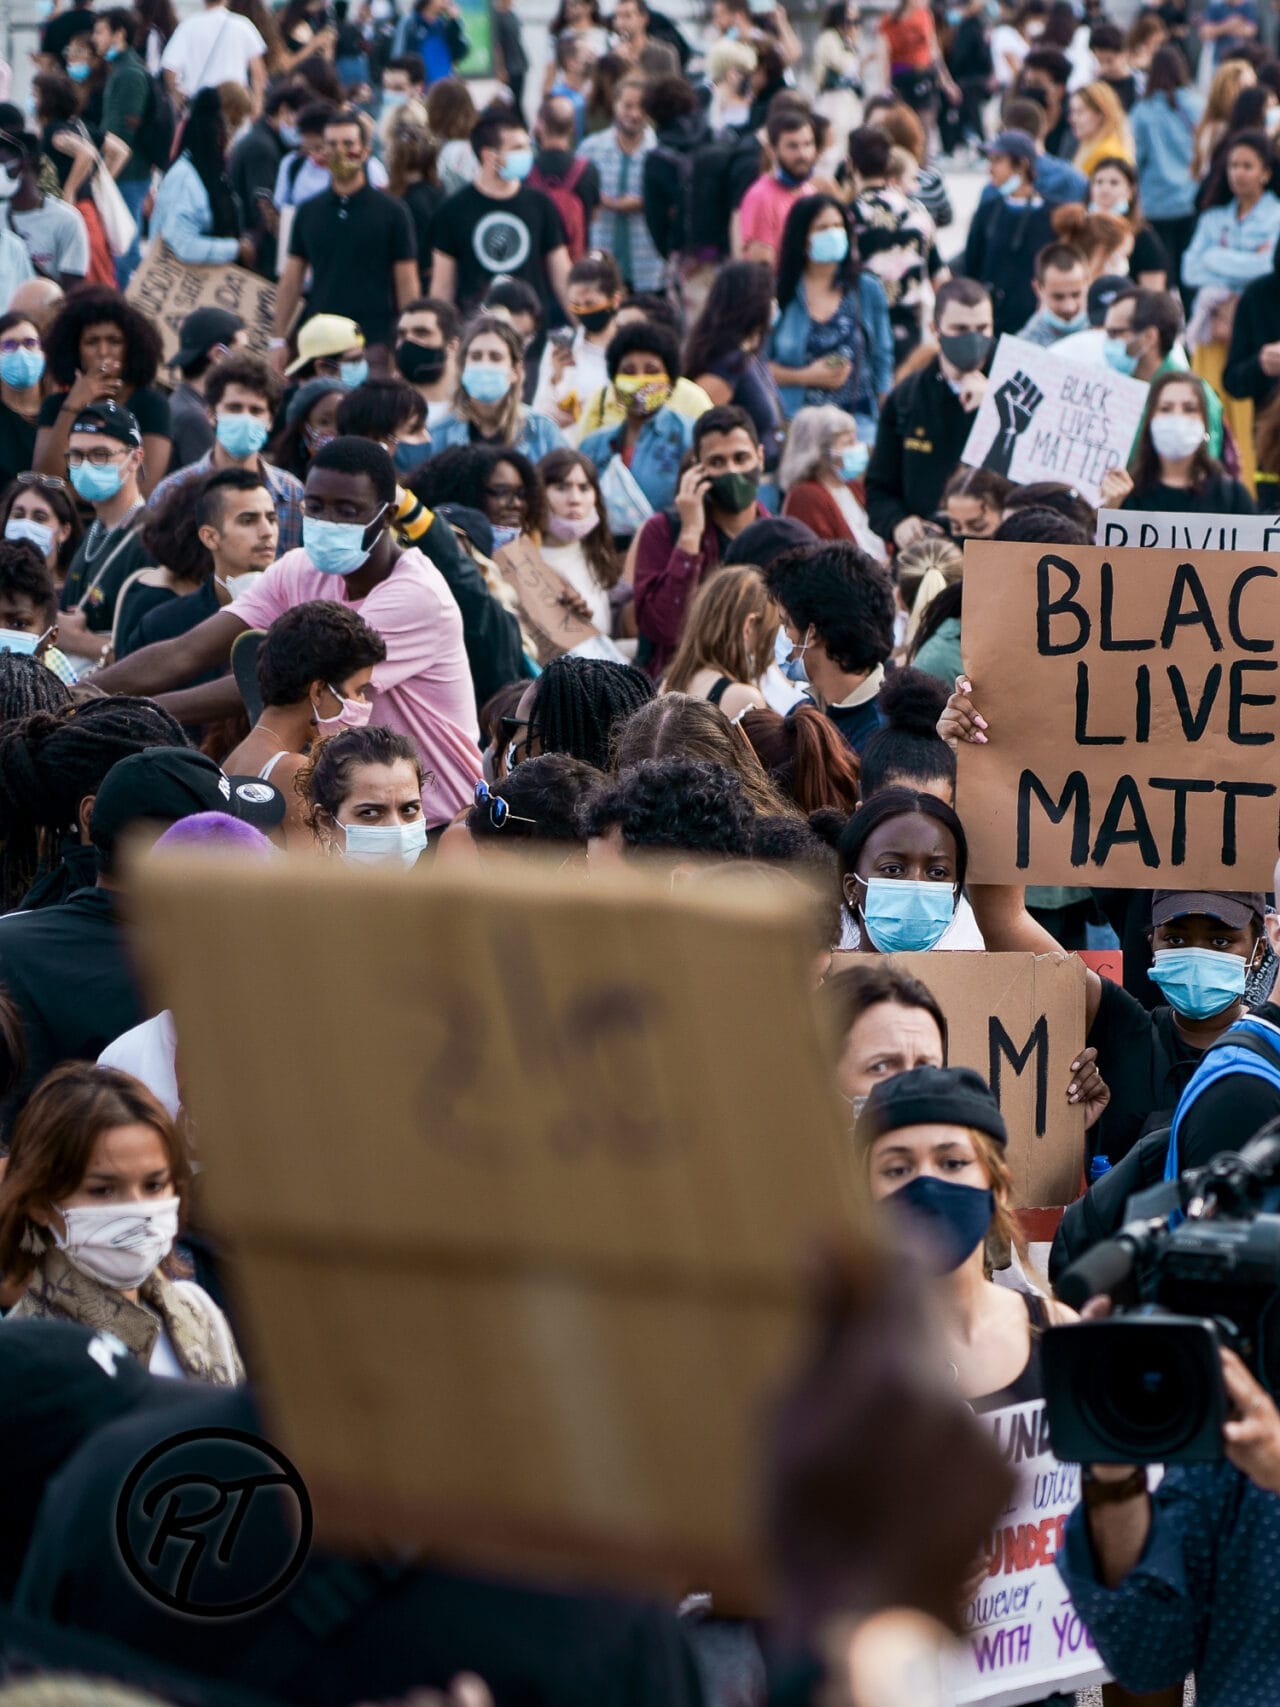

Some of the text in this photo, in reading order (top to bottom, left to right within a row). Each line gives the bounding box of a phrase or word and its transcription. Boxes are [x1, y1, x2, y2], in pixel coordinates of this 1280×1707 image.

[1060, 375, 1113, 414] BLACK
[1059, 407, 1111, 446] LIVES
[974, 1621, 1032, 1674] WITH
